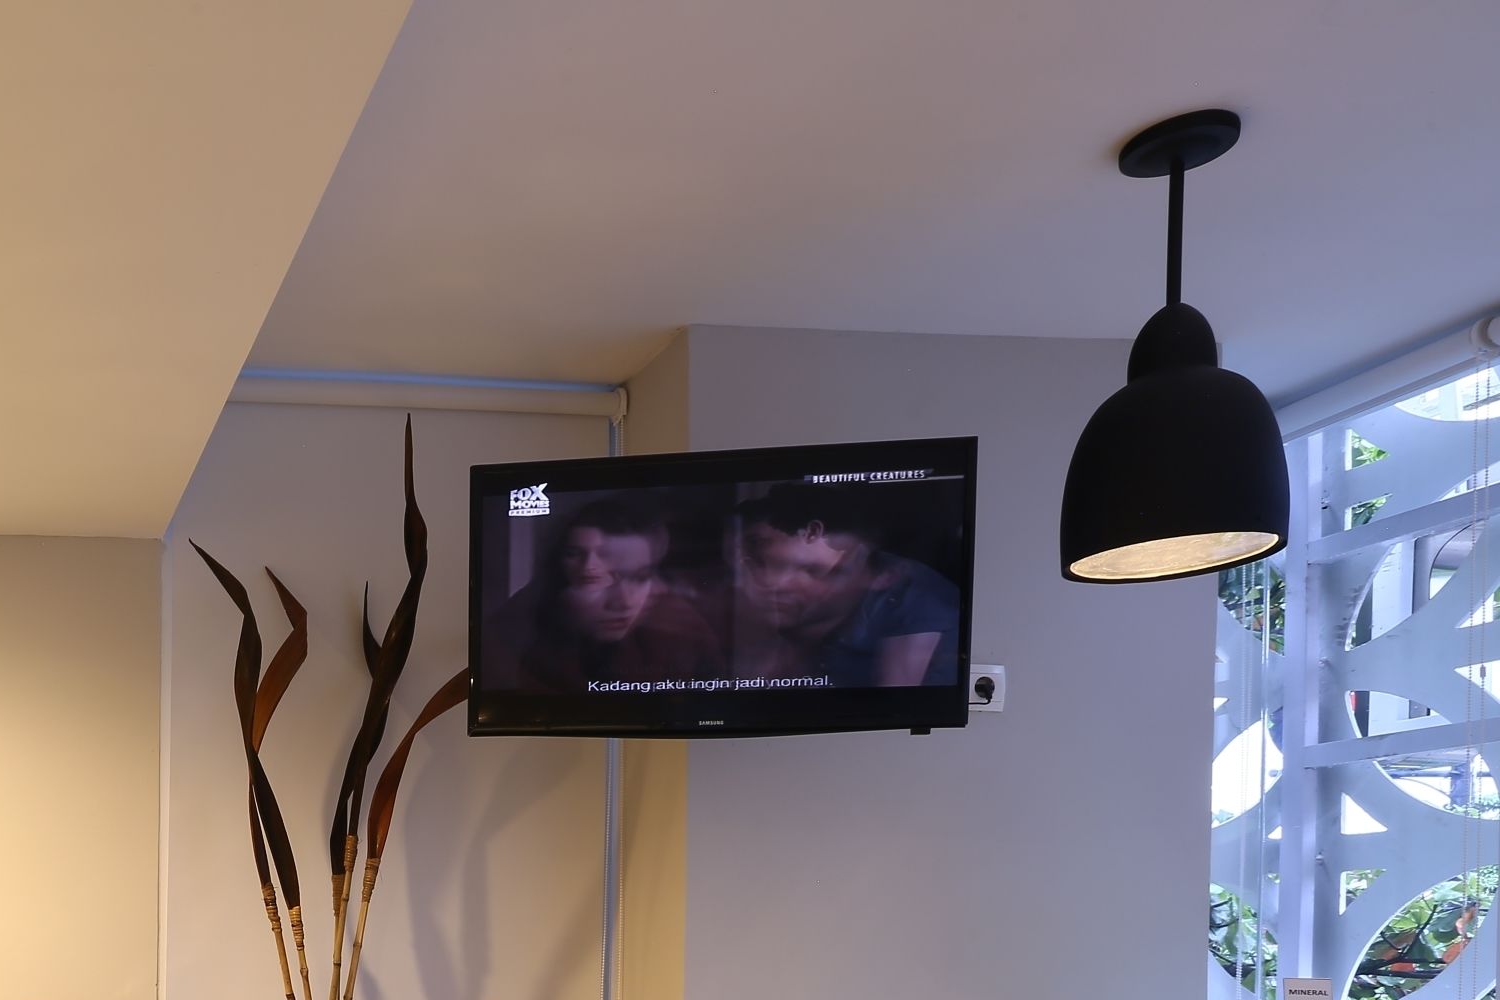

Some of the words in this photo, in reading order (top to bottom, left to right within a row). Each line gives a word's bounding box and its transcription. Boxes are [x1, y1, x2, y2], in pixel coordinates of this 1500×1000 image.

[813, 473, 866, 484] BEAUTIFUL
[869, 470, 925, 480] CREATURES
[510, 483, 549, 500] FOX
[588, 680, 650, 692] Kadang
[655, 679, 686, 691] aku
[691, 678, 730, 691] ingin
[734, 677, 764, 690] jadi
[769, 675, 833, 689] normal.
